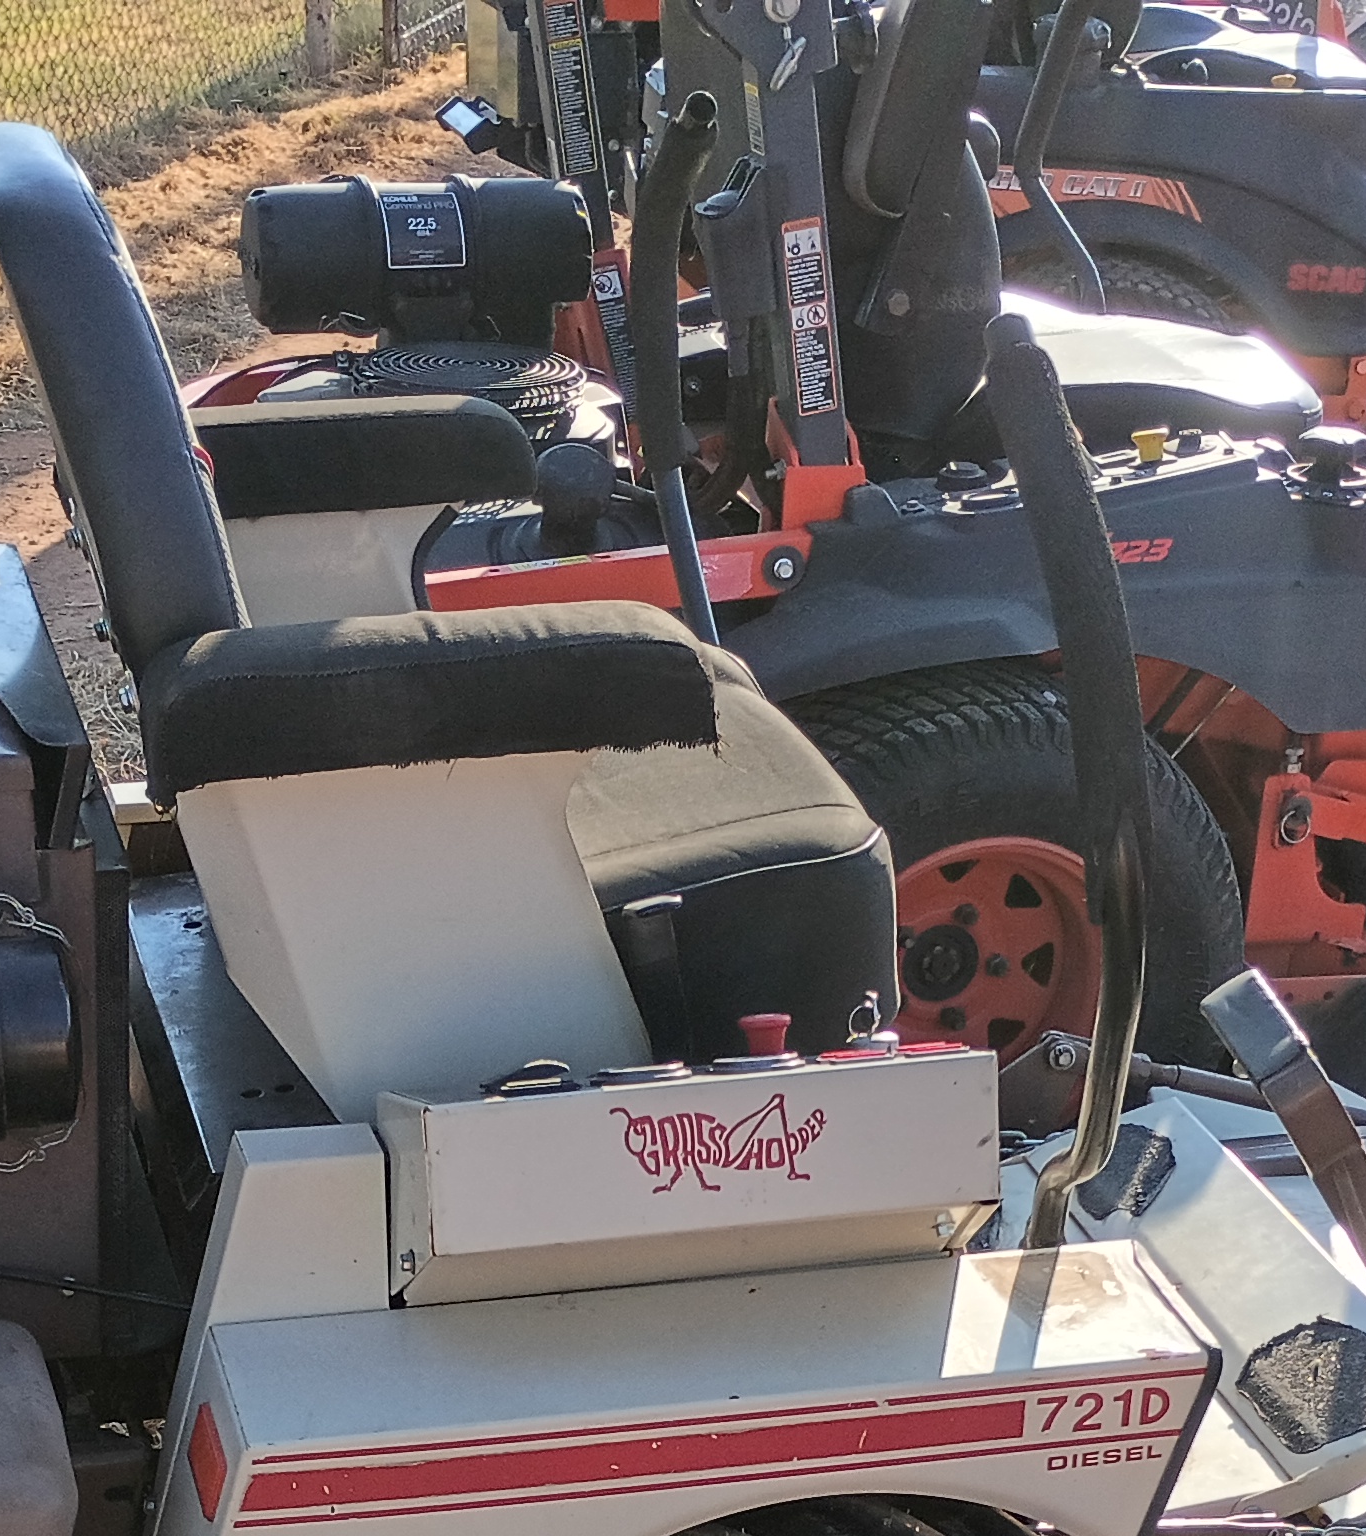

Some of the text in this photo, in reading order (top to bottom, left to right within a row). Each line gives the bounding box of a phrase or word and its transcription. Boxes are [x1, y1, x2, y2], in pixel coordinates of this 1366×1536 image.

[1062, 174, 1127, 197] CAT
[385, 201, 455, 210] Command PRO
[1288, 263, 1366, 294] SCAG
[611, 1094, 827, 1192] GRASSHOPPER
[1037, 1387, 1170, 1432] 721D
[1047, 1445, 1162, 1471] DIESEL
